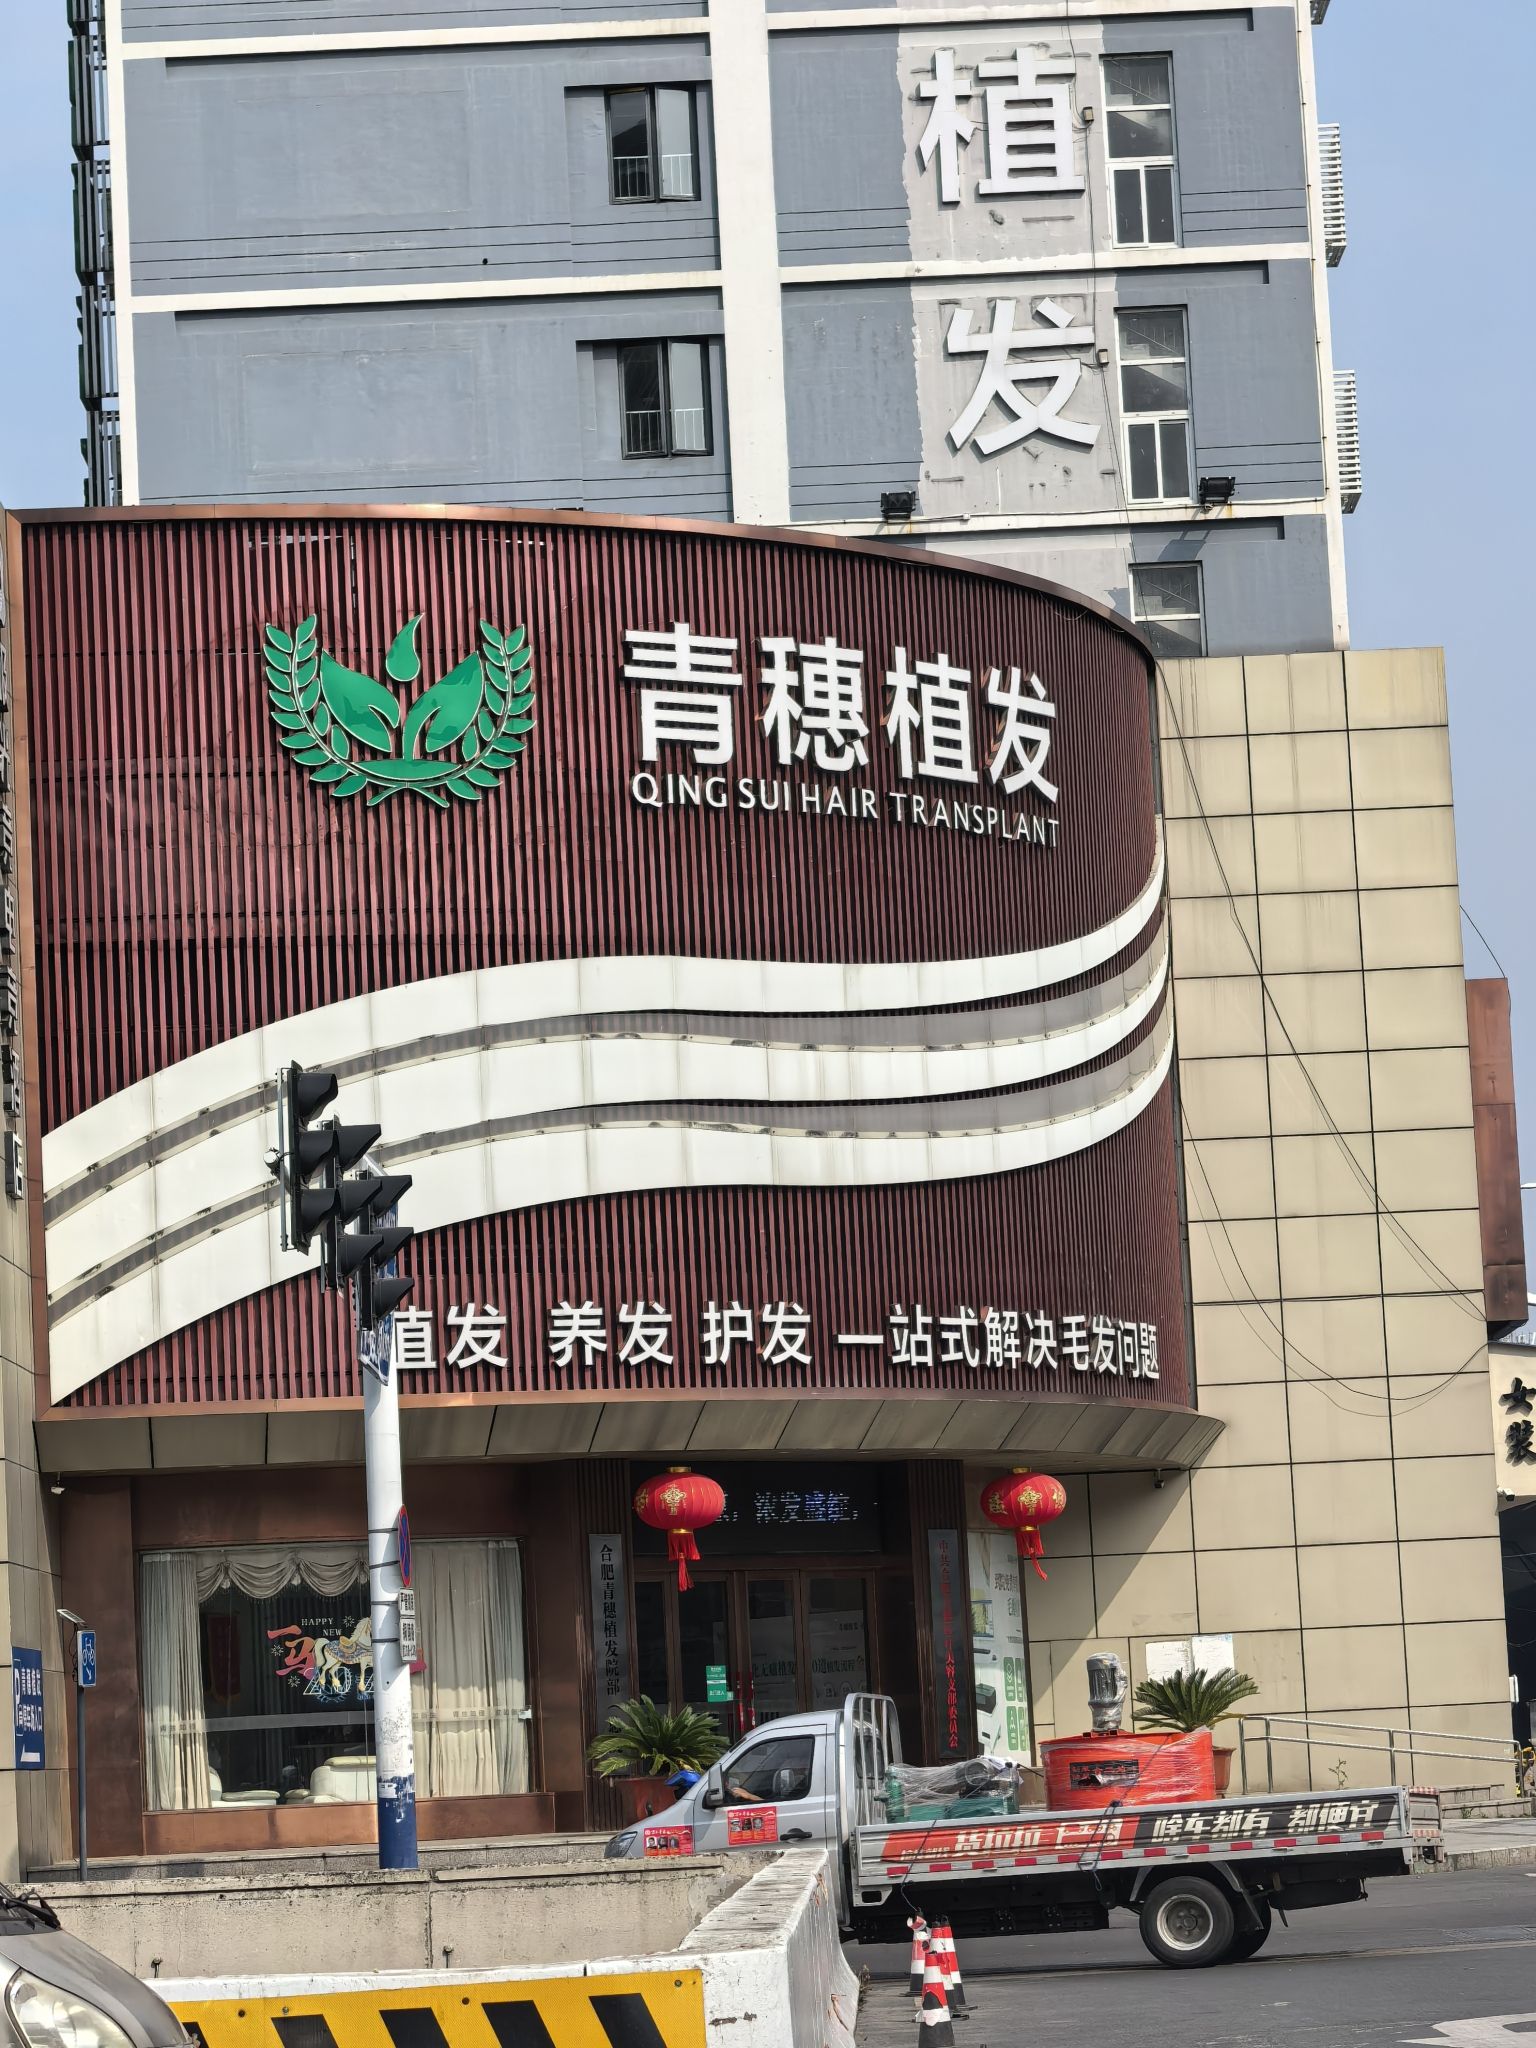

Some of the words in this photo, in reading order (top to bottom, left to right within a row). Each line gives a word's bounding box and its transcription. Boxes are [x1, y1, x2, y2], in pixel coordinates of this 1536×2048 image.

[917, 47, 1101, 455] 植发
[622, 621, 1060, 803] 青穗植发
[631, 772, 728, 808] QING
[737, 777, 790, 812] SUI
[800, 782, 879, 819] HAIR
[889, 791, 1060, 848] TRANSPLANT
[548, 1300, 674, 1368] 养发
[702, 1300, 813, 1367] 护发
[837, 1303, 1160, 1381] 一站式解决毛发问题
[301, 1617, 333, 1626] HAPPY
[322, 1628, 342, 1636] NEW
